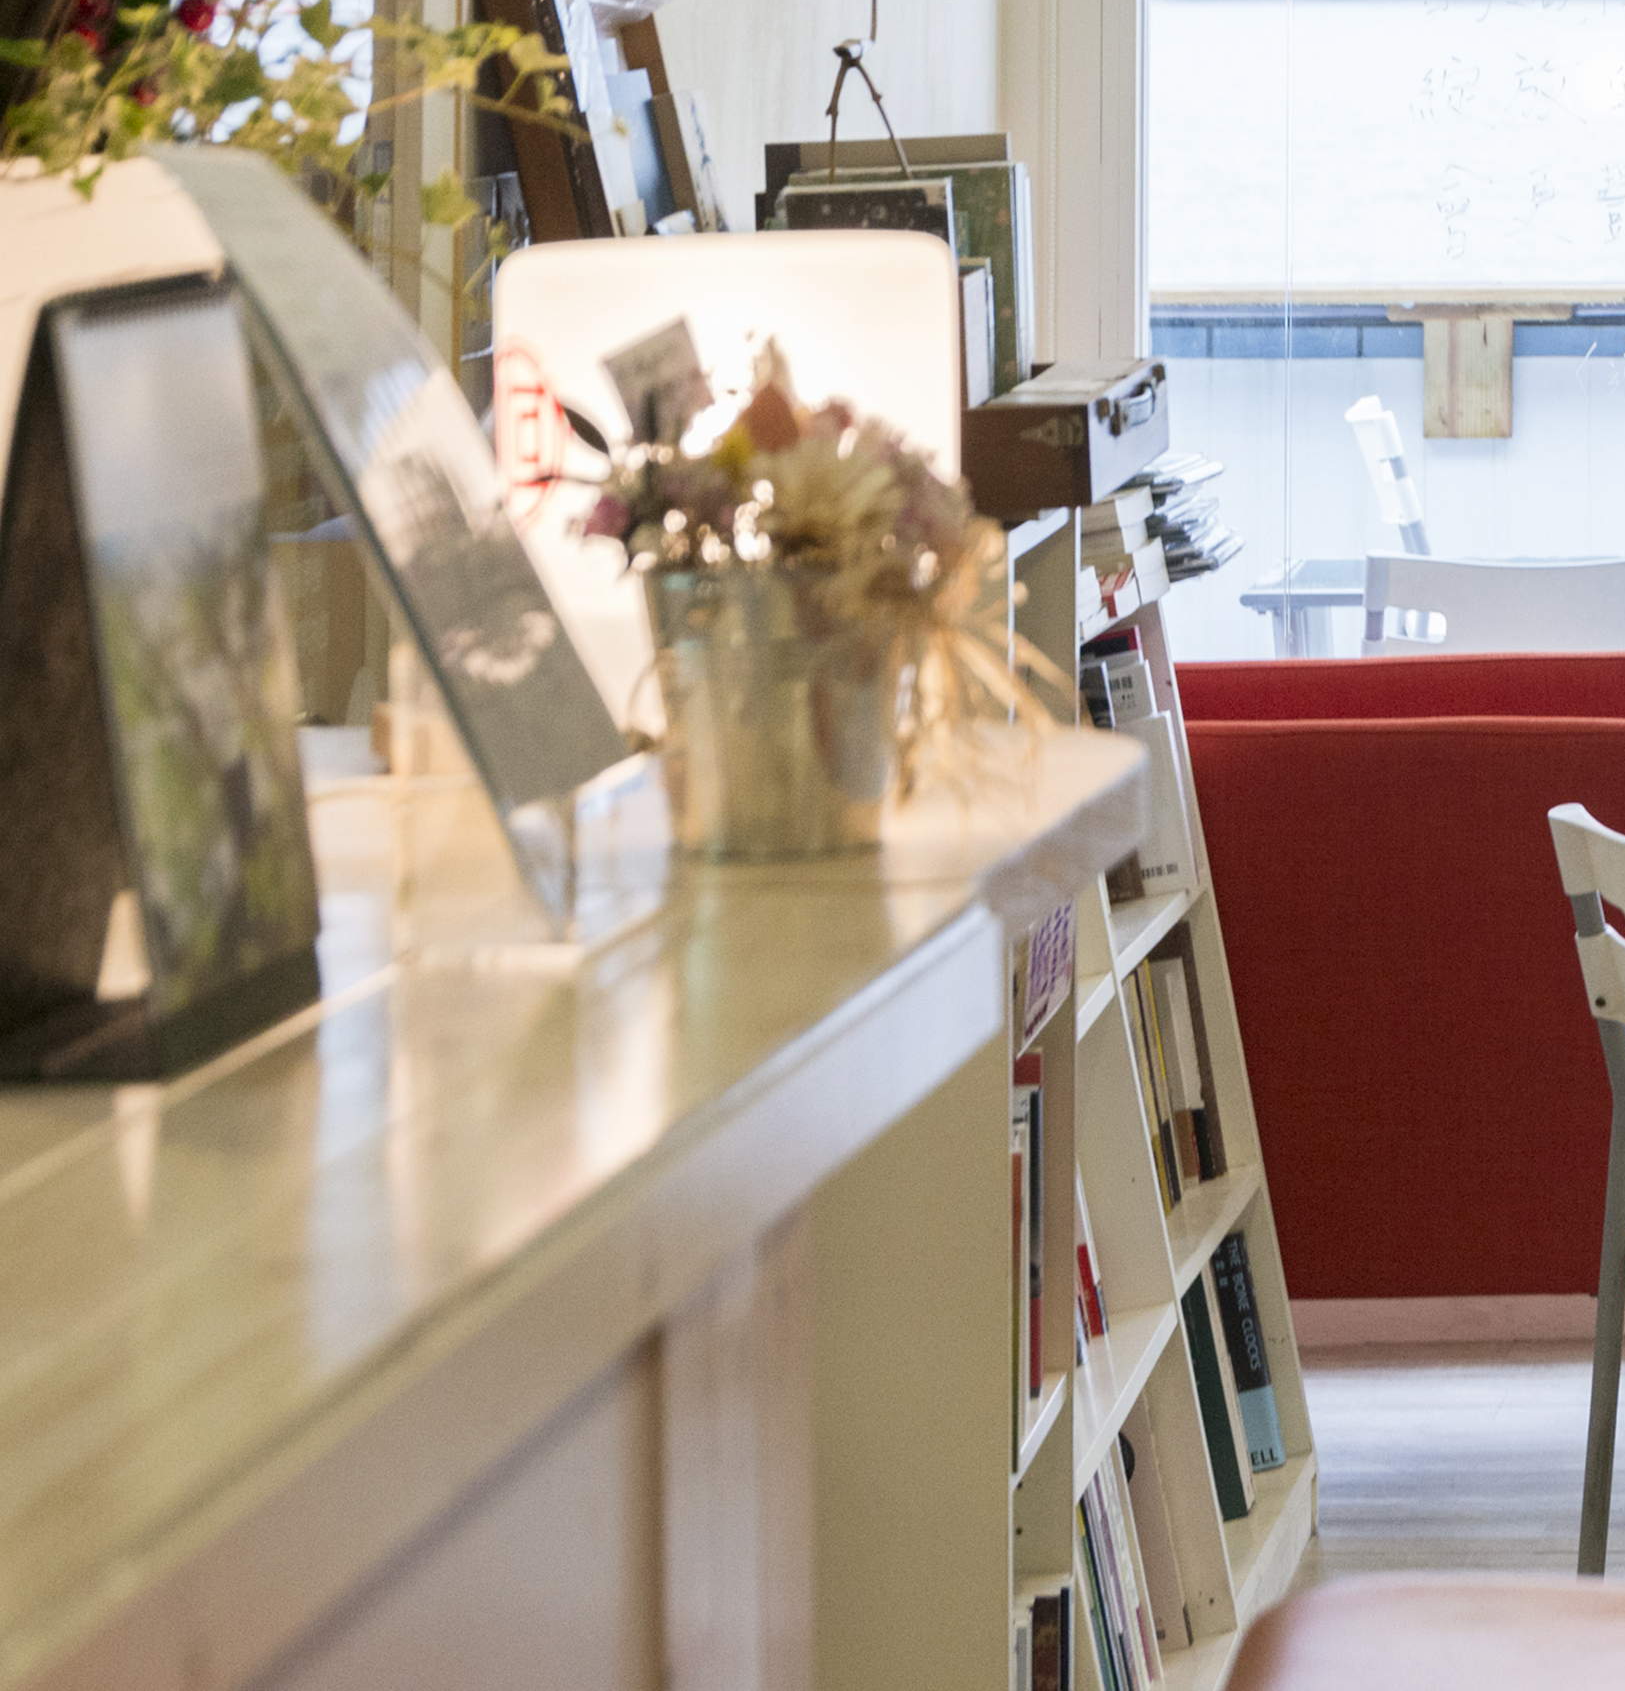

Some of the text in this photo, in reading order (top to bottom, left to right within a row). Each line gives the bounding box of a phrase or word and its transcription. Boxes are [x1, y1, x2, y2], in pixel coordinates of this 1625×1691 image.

[1226, 1238, 1262, 1372] THE BONE CLOCKS
